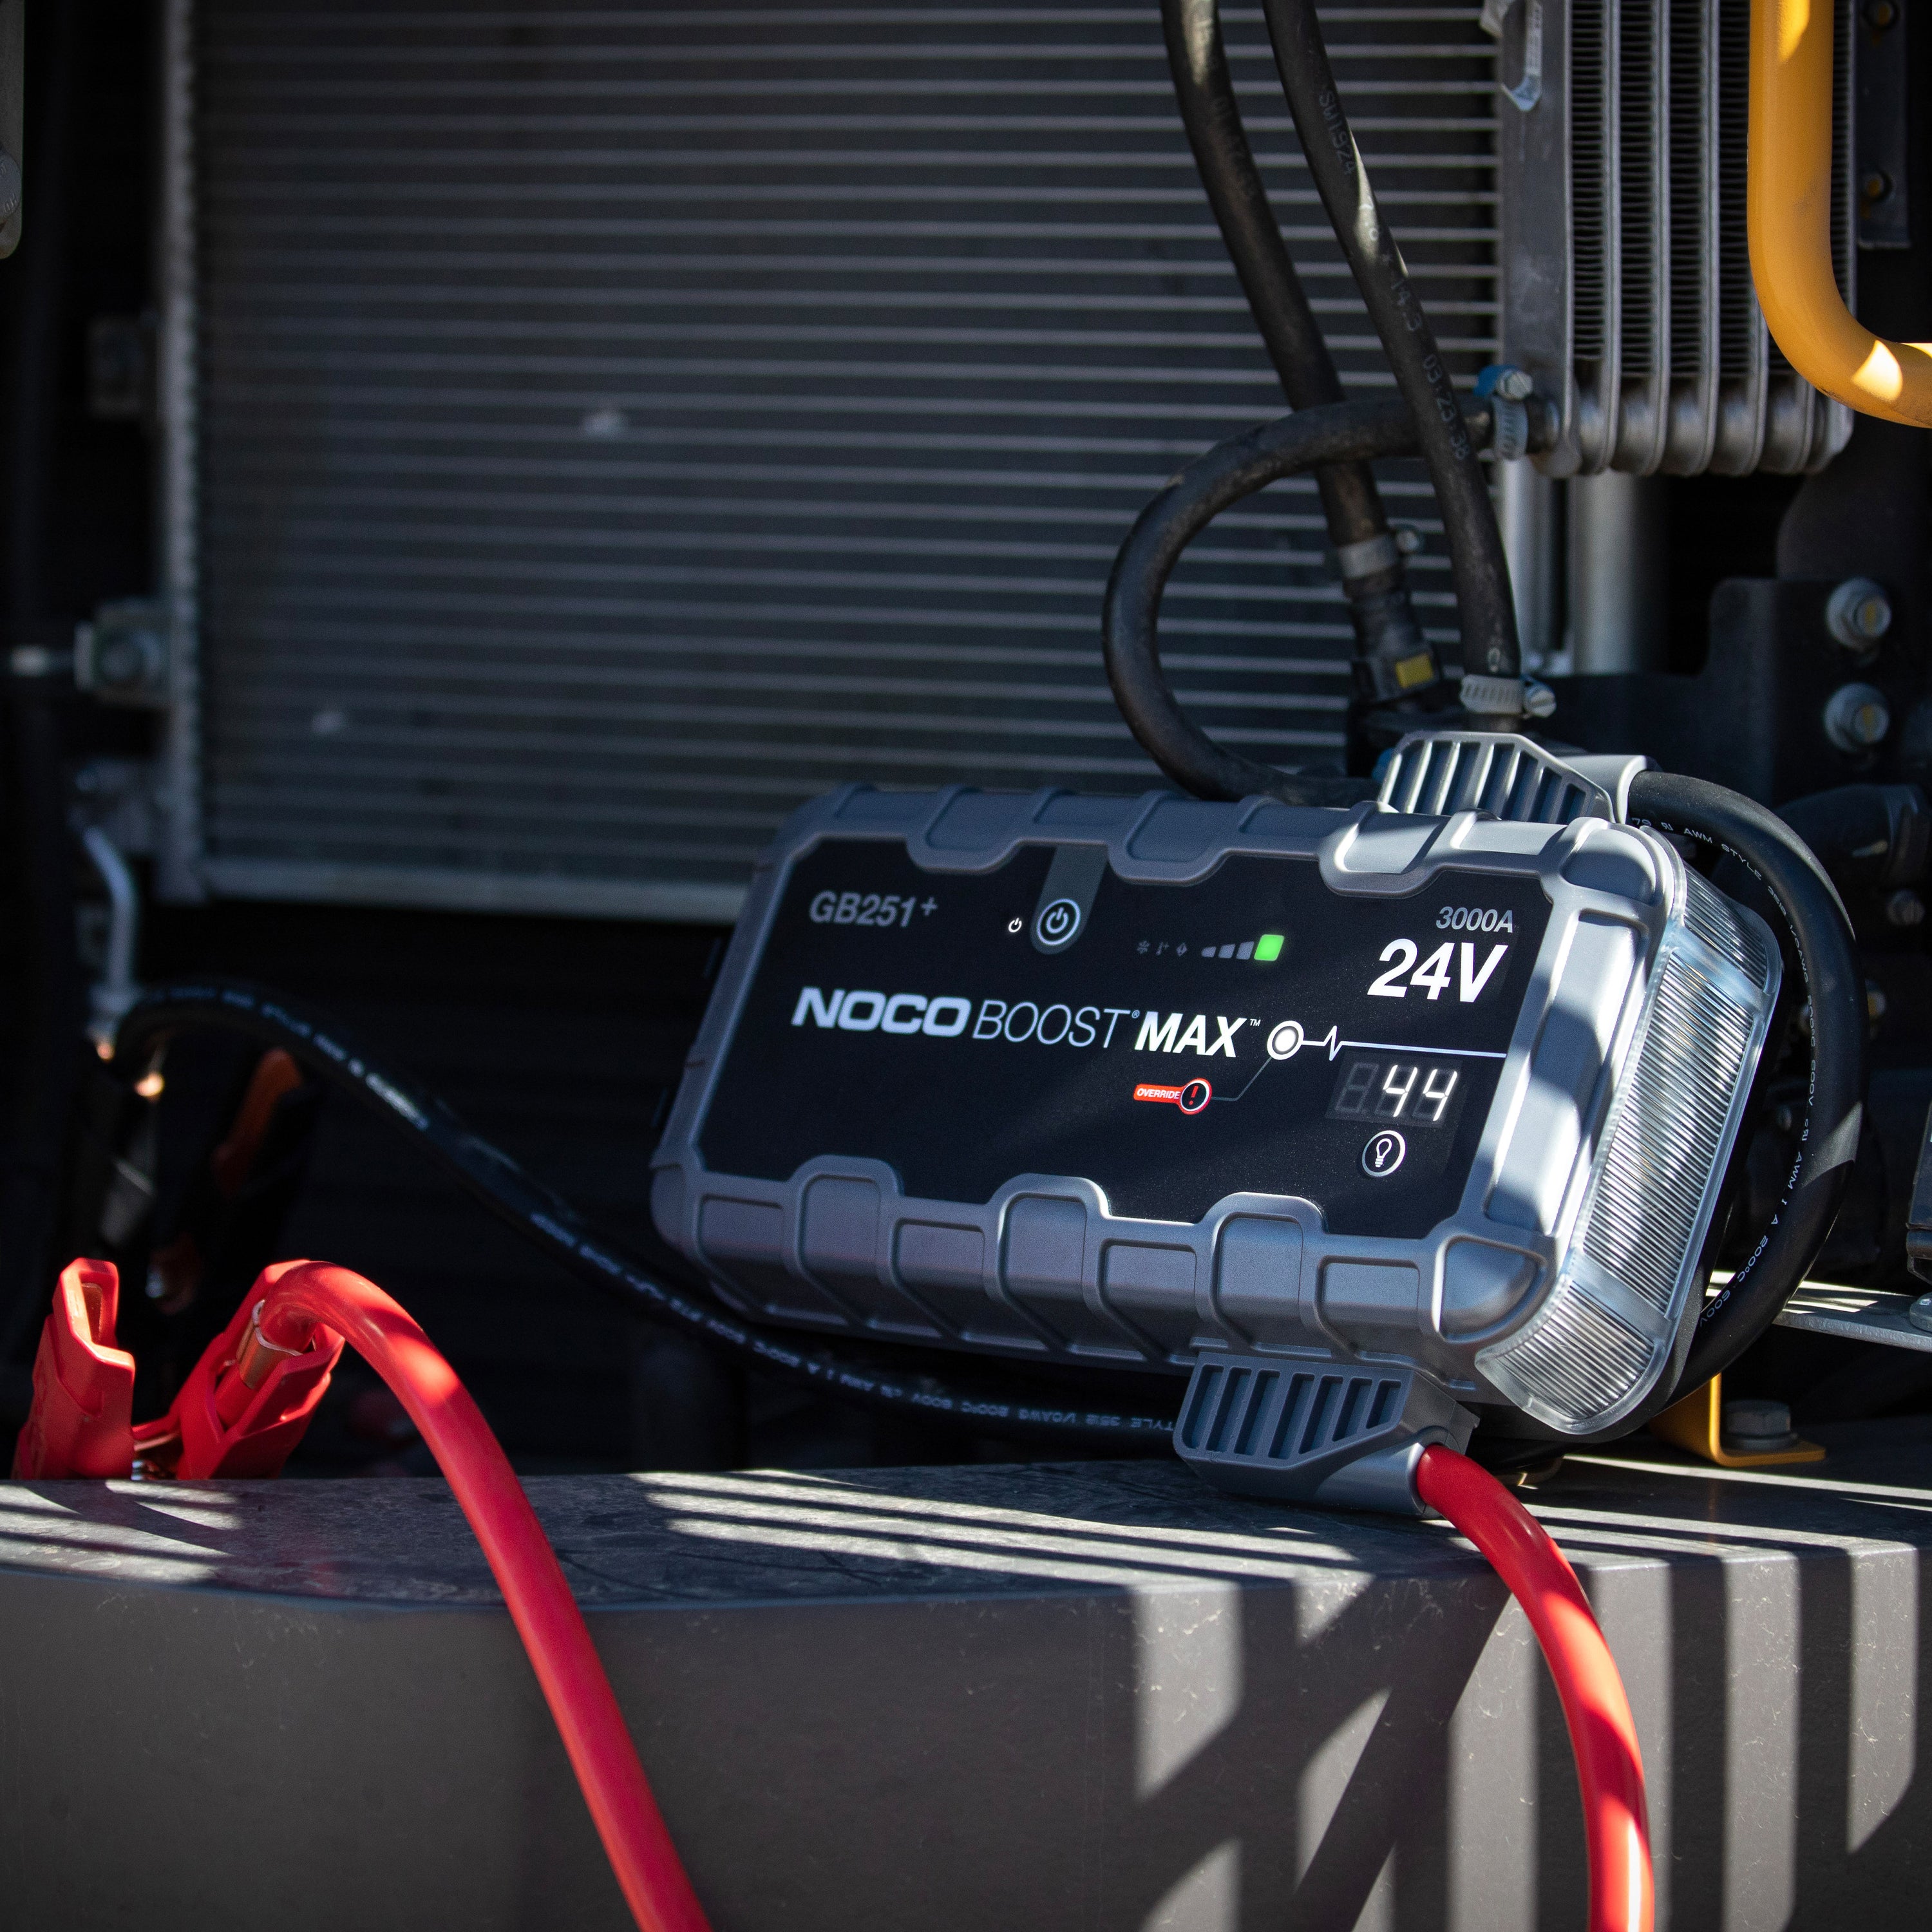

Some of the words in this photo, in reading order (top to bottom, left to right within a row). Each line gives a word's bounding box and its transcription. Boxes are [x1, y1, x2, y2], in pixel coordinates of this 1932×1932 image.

[1683, 828, 1712, 844] AWM
[1721, 844, 1762, 880] STYLE
[1435, 906, 1513, 933] 3000A
[1367, 938, 1509, 1003] 24V
[791, 985, 971, 1037] NOCO
[1136, 1088, 1181, 1100] OVERRIDE
[1383, 1065, 1458, 1122] 44
[1788, 1151, 1802, 1189] AWM
[1771, 1214, 1779, 1224] A
[1700, 1289, 1730, 1327] 600V
